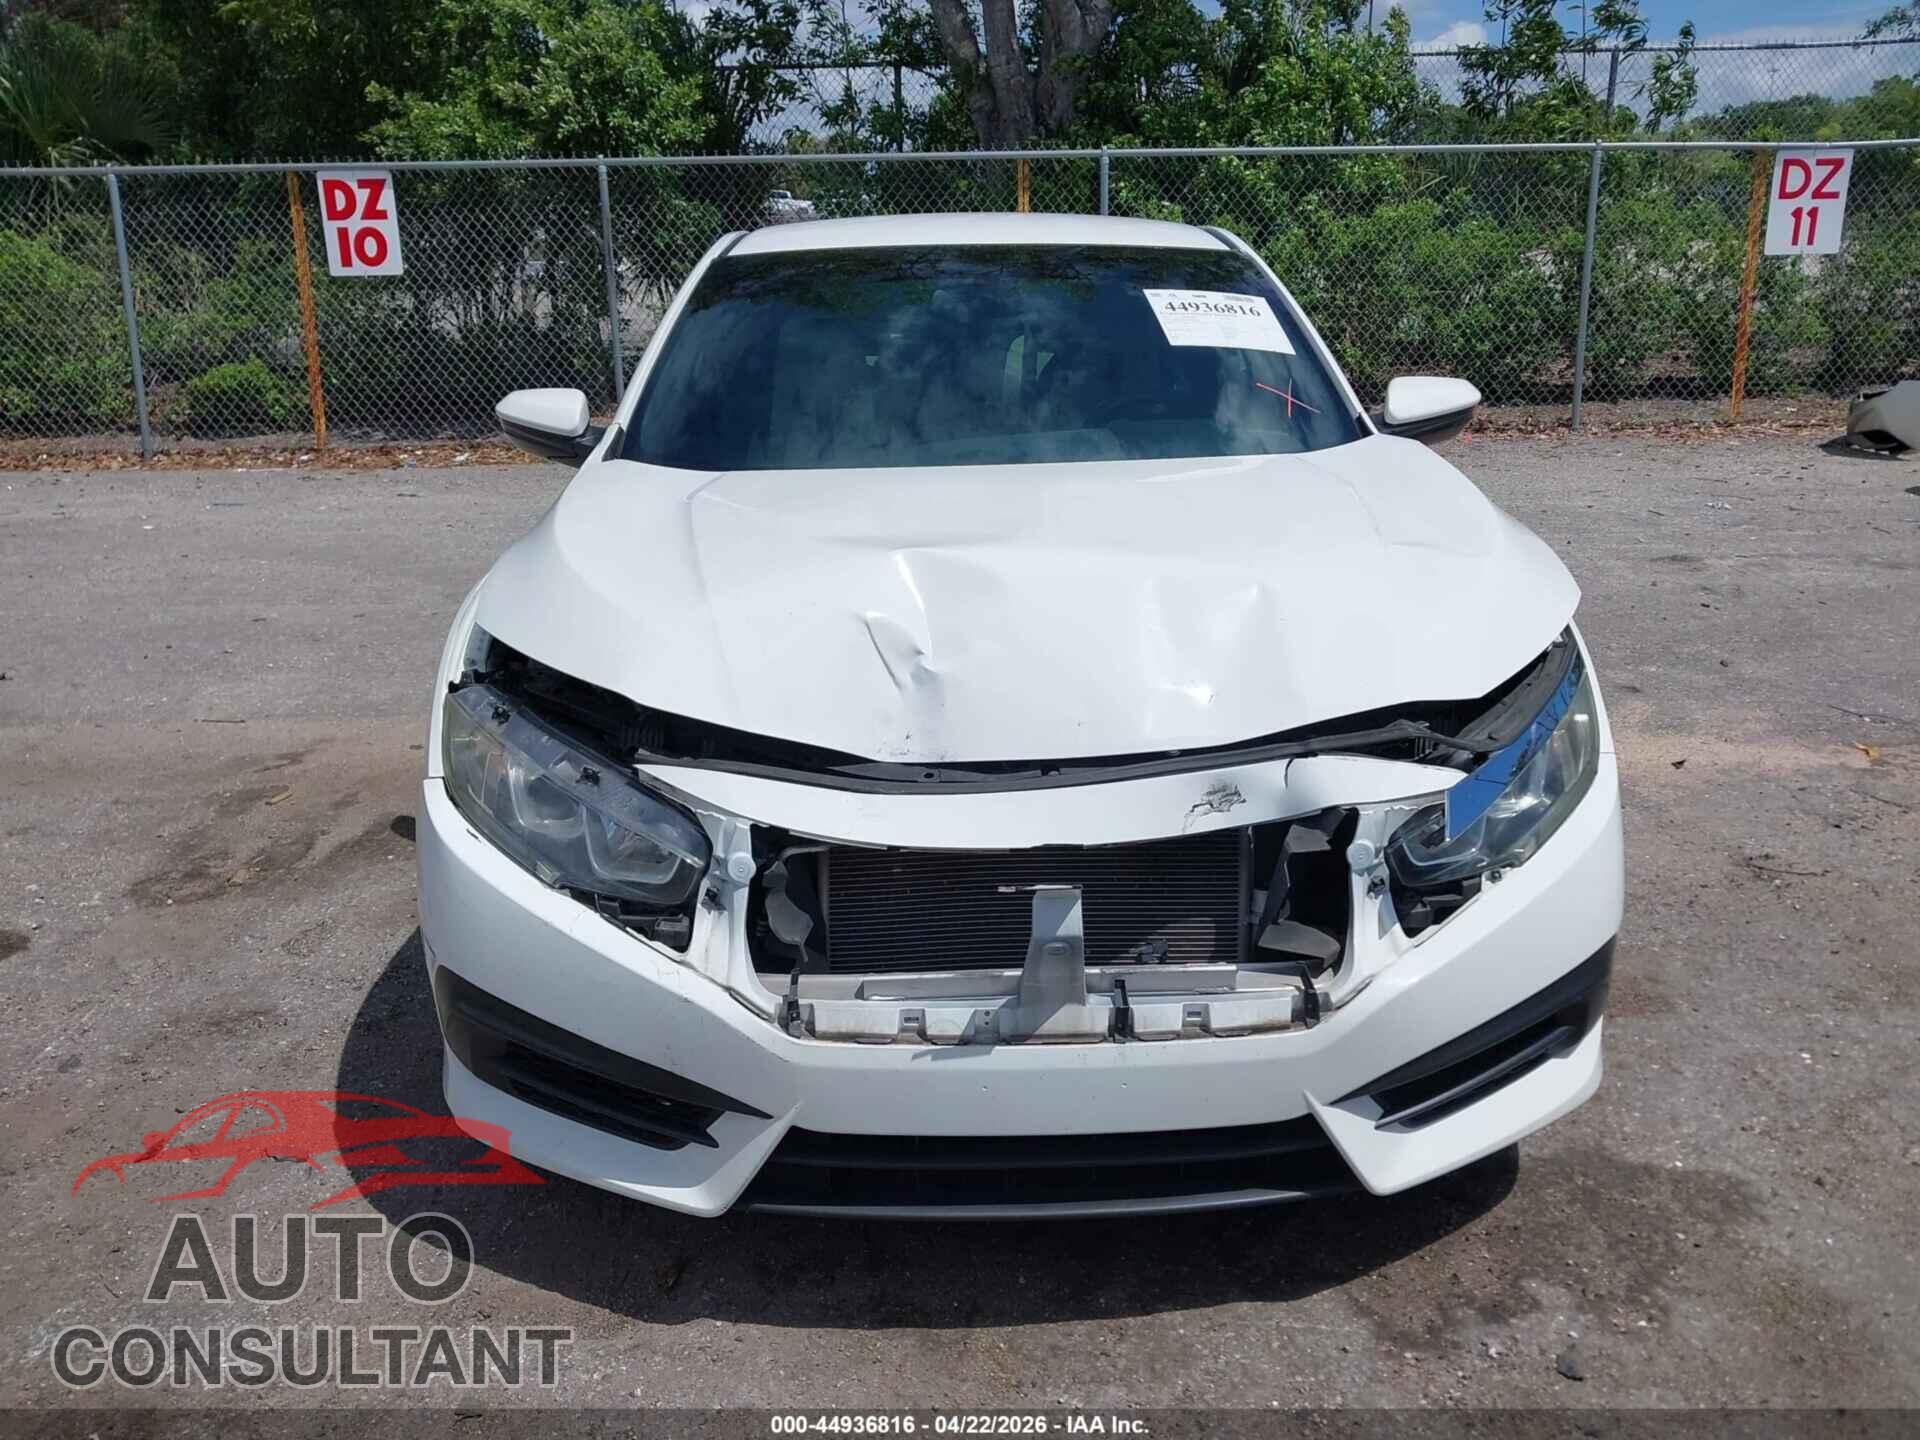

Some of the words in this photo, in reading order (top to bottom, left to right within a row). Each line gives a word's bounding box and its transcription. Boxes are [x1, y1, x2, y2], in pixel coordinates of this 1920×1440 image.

[1778, 157, 1846, 200] DZ
[322, 178, 389, 221] DZ
[1791, 206, 1820, 246] 11
[1164, 301, 1262, 317] 44936816
